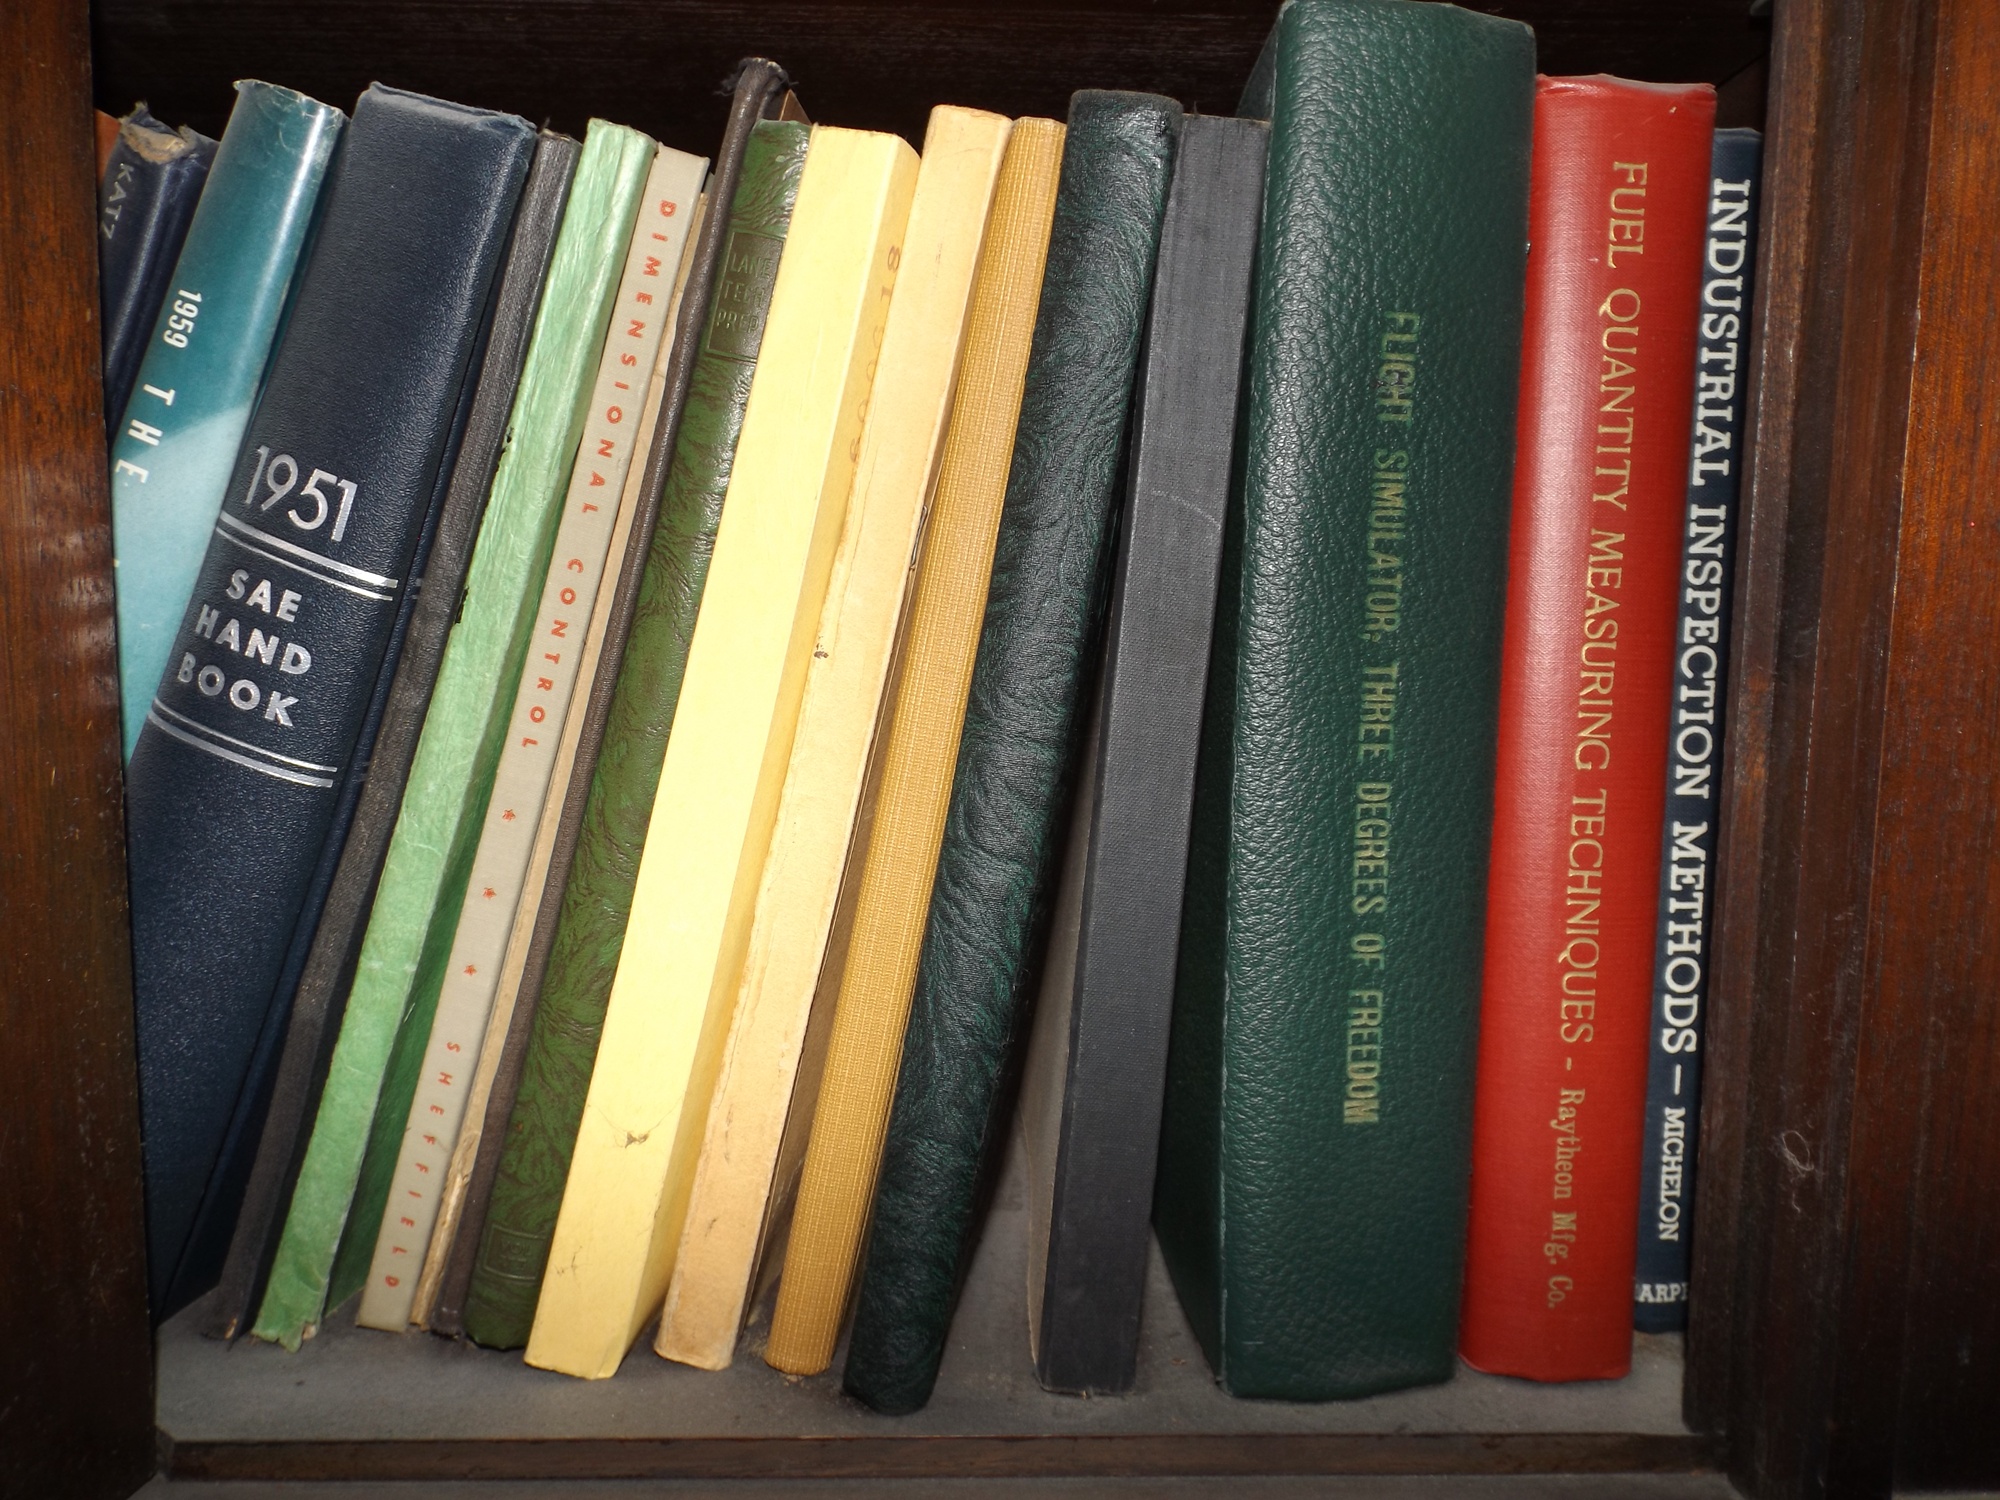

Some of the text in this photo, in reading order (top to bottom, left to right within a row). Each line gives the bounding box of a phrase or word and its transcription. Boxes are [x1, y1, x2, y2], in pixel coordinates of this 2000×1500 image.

[102, 163, 134, 239] KATZ
[1606, 161, 1648, 269] FUEL
[715, 308, 760, 333] PREP
[730, 253, 772, 279] LANE
[115, 288, 202, 484] 1959 THE
[1376, 311, 1420, 428] FLIGHT
[1692, 178, 1751, 487] INDUSTRIAL
[1592, 288, 1641, 512] QUANTITY
[246, 445, 358, 542] 1951
[521, 199, 677, 748] DIMENSIONAL CONTROL
[195, 604, 312, 675] HAND
[226, 569, 303, 623] SAE
[1574, 528, 1626, 771] MEASURING
[1675, 504, 1727, 800] INSPECTION
[177, 652, 300, 727] BOOK
[1357, 659, 1398, 763] THREE
[1352, 782, 1392, 914] DEGREES
[1350, 933, 1386, 970] OF
[1557, 789, 1607, 1043] TECHNIQUES
[1661, 821, 1708, 1054] METHODS
[1343, 989, 1383, 1124] FREEDOM
[385, 1041, 461, 1288] SHEFFIELD
[1550, 1087, 1586, 1200] Raytheon
[1658, 1106, 1686, 1242] MICHELON
[1544, 1212, 1577, 1264] Mfg.
[1548, 1275, 1573, 1309] Co.
